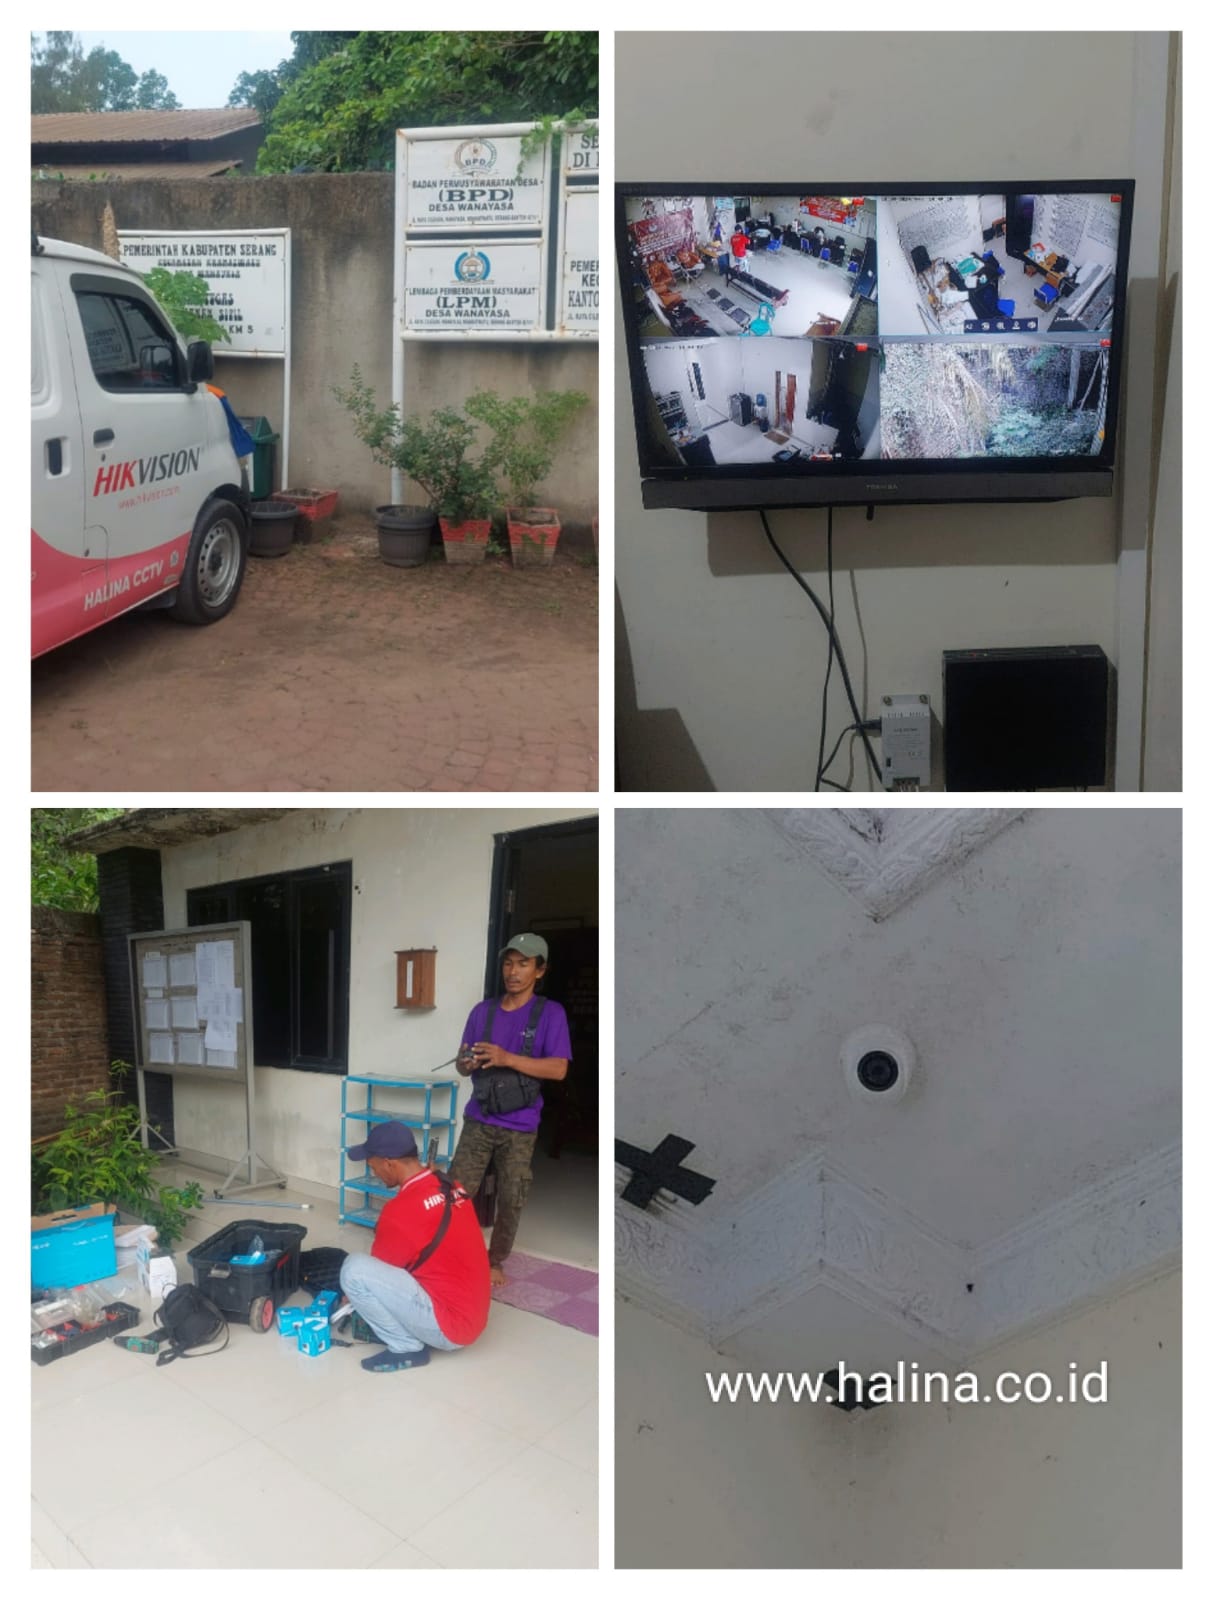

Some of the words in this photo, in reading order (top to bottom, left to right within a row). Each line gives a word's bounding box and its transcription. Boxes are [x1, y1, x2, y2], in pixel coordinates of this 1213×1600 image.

[412, 180, 437, 189] BADAN
[518, 178, 539, 187] DESA
[438, 188, 514, 202] (BPD)
[429, 203, 455, 212] DESA
[458, 202, 515, 211] WANAYASA
[123, 244, 178, 256] PEMERINTAH
[181, 244, 237, 256] KABUPATEN
[240, 244, 277, 256] SERANG
[409, 287, 438, 296] LEMBAGA
[440, 287, 490, 296] PEMBERDAYAAN
[492, 287, 536, 296] MASYARAKAT
[436, 295, 498, 309] (LPM)
[425, 309, 451, 318] DESA
[454, 309, 511, 318] WANAYASA
[229, 325, 243, 334] KM
[247, 325, 254, 334] 5
[93, 446, 201, 497] HIKVISION
[84, 576, 130, 612] HALINA
[133, 560, 164, 587] CCTV
